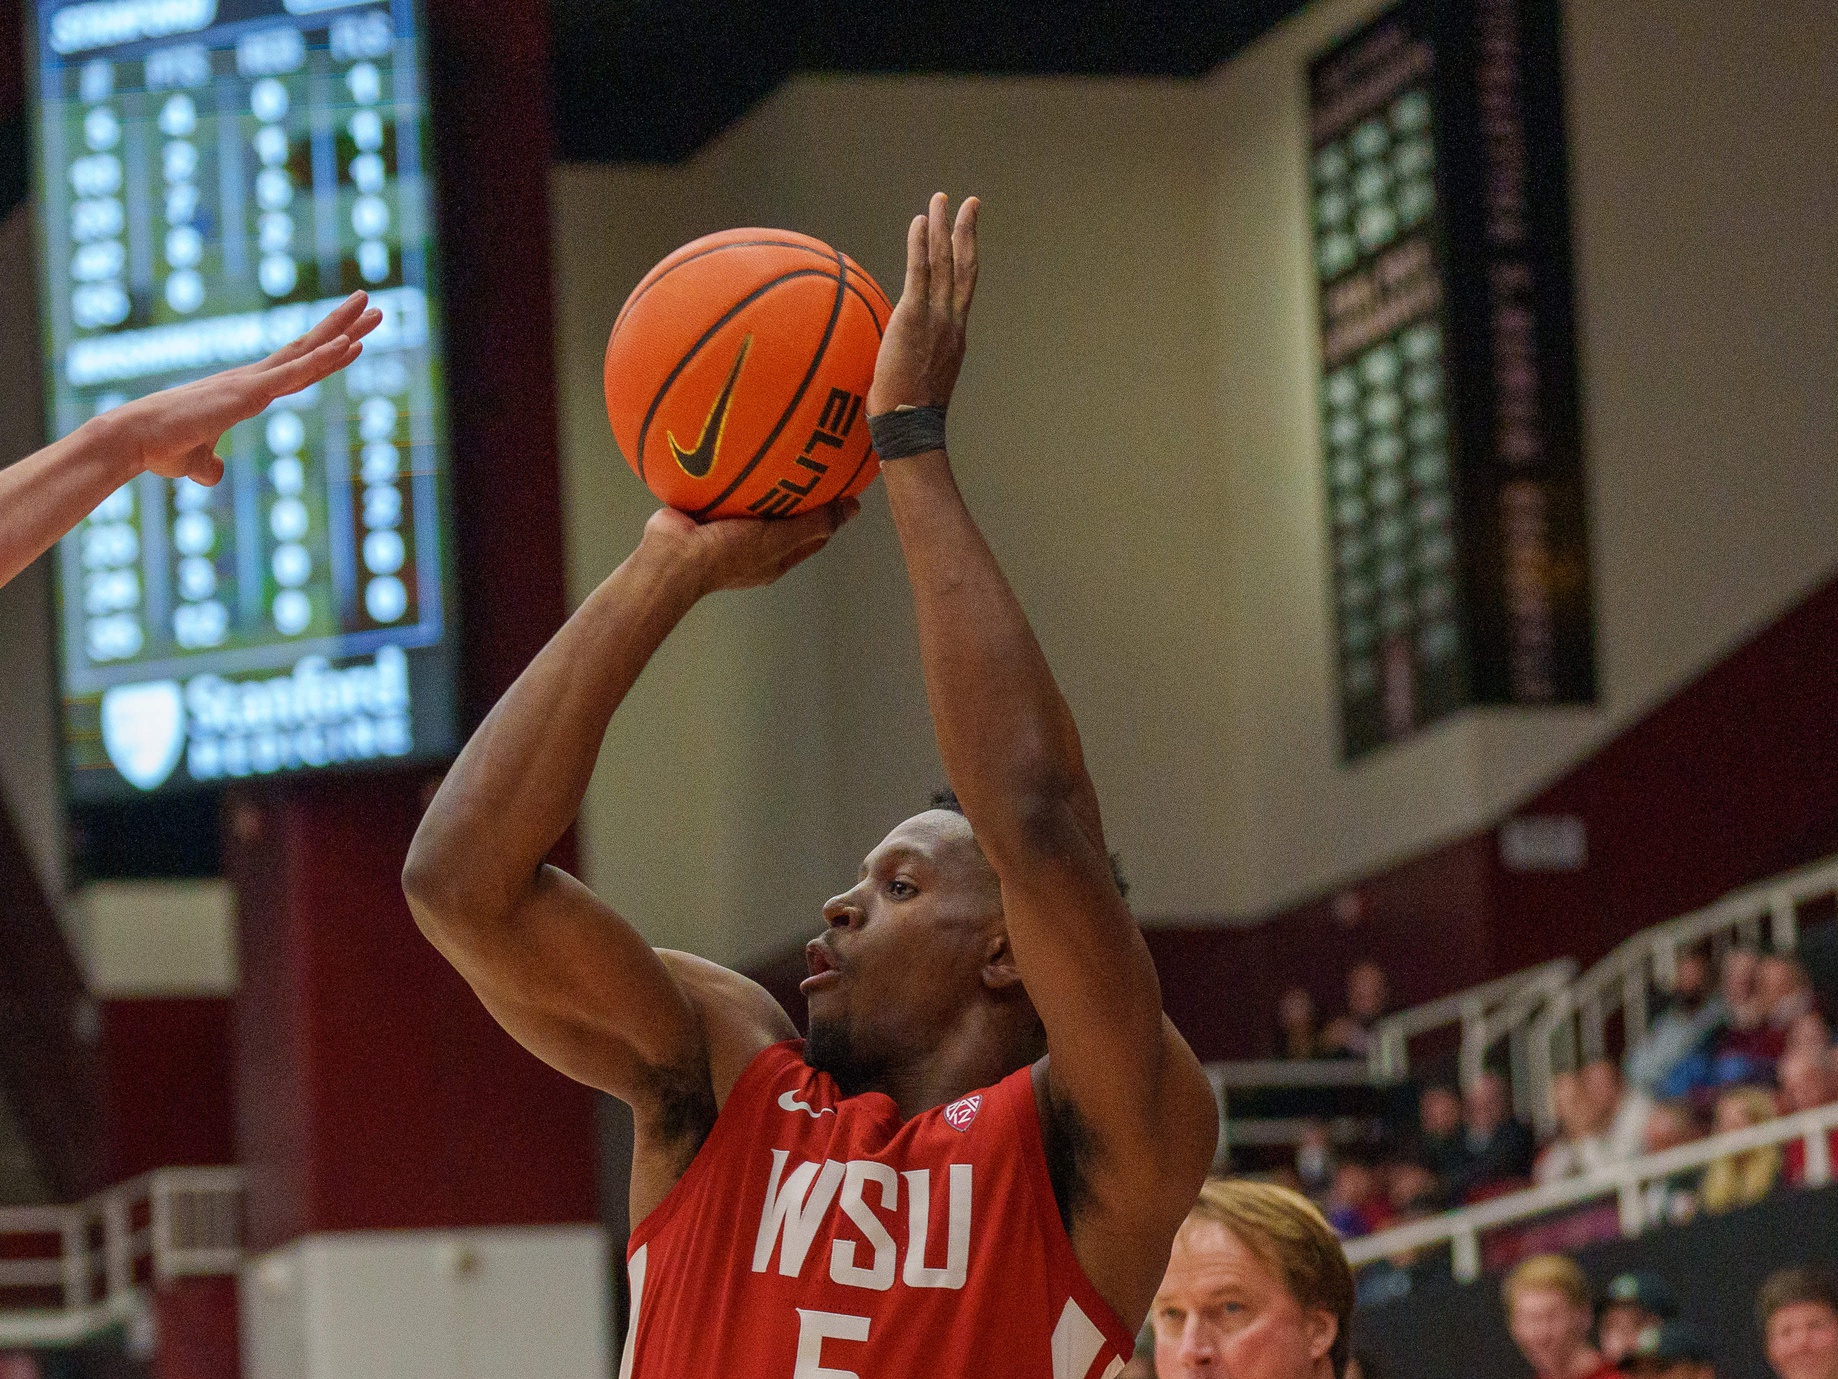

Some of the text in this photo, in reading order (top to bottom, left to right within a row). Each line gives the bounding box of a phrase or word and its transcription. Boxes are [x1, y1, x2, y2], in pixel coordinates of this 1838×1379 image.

[747, 386, 862, 518] ELITE
[945, 1095, 981, 1121] PAC
[953, 1108, 972, 1125] 12
[751, 1148, 973, 1292] WSU
